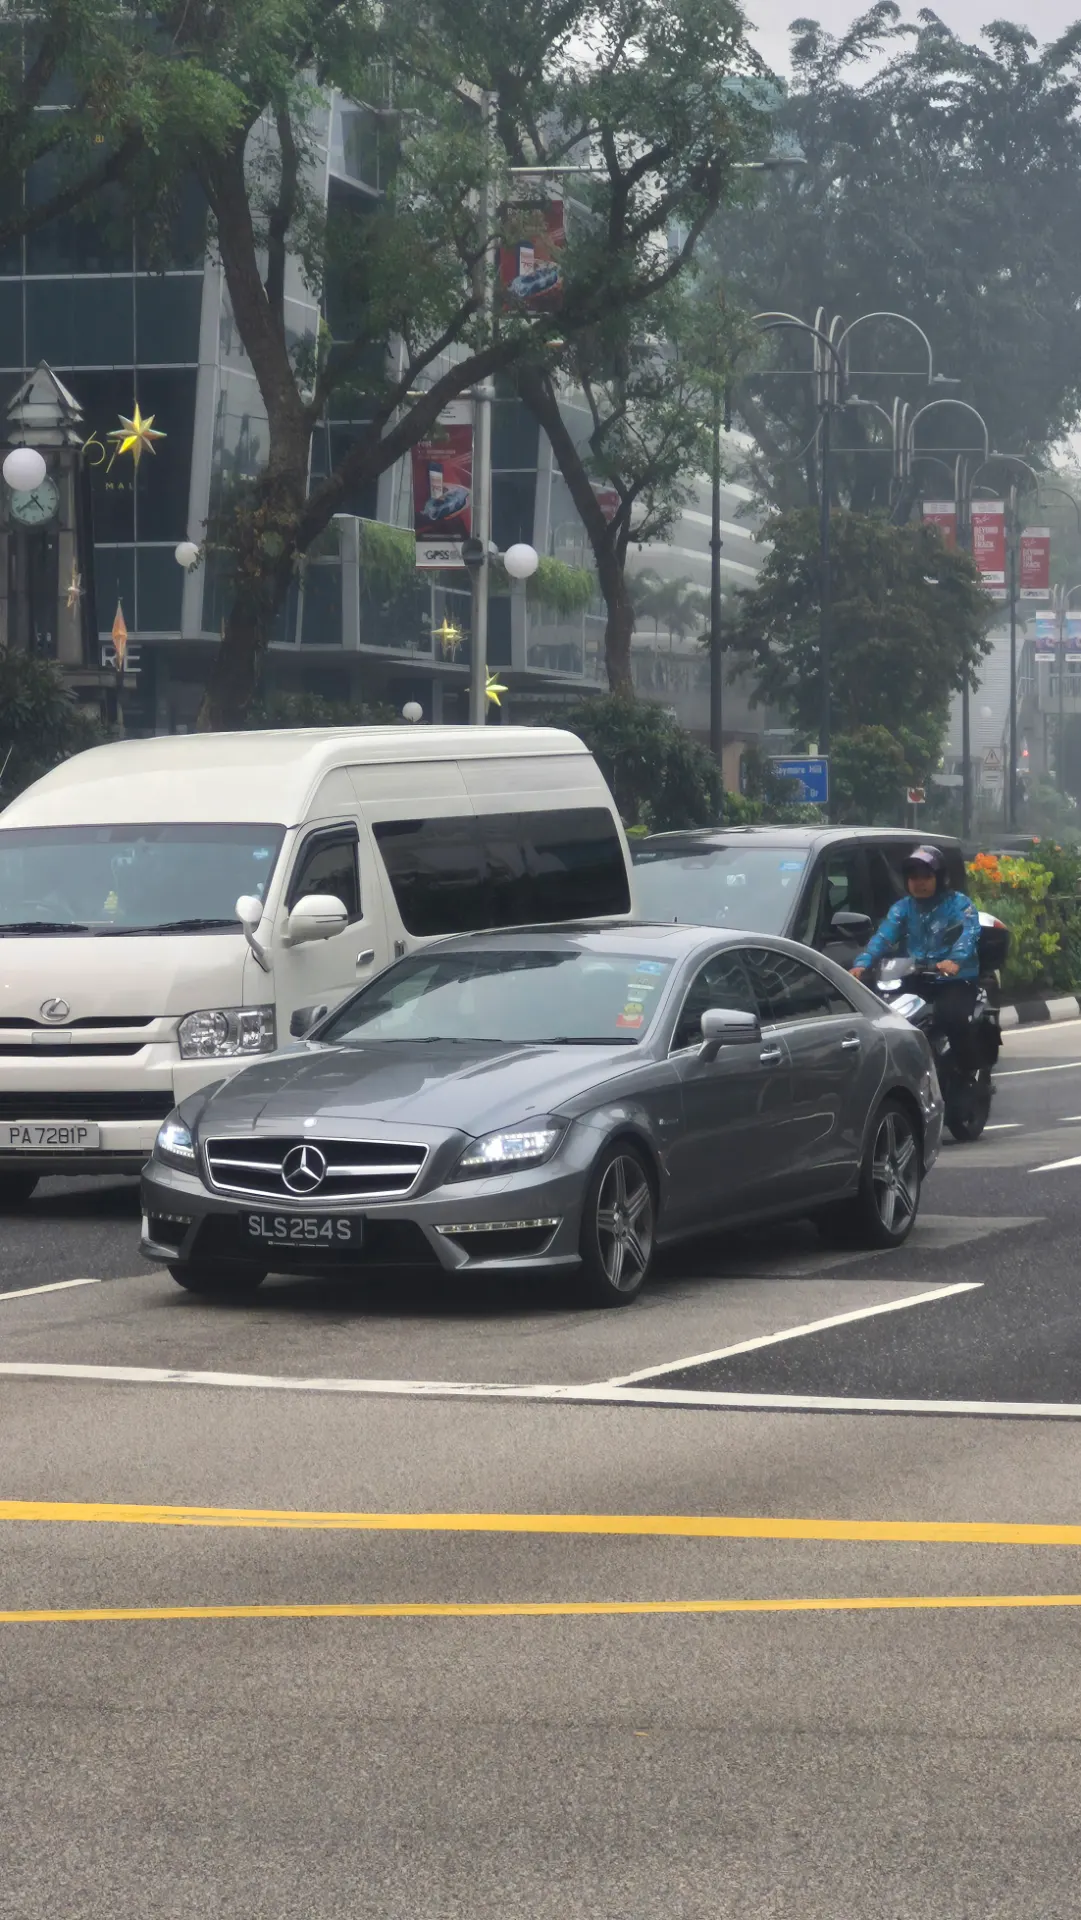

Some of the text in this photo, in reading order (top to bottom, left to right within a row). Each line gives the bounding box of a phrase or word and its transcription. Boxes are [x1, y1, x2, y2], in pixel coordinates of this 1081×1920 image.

[105, 482, 139, 490] MAL
[9, 1127, 88, 1144] PA7281P
[248, 1215, 351, 1240] SLS254S
